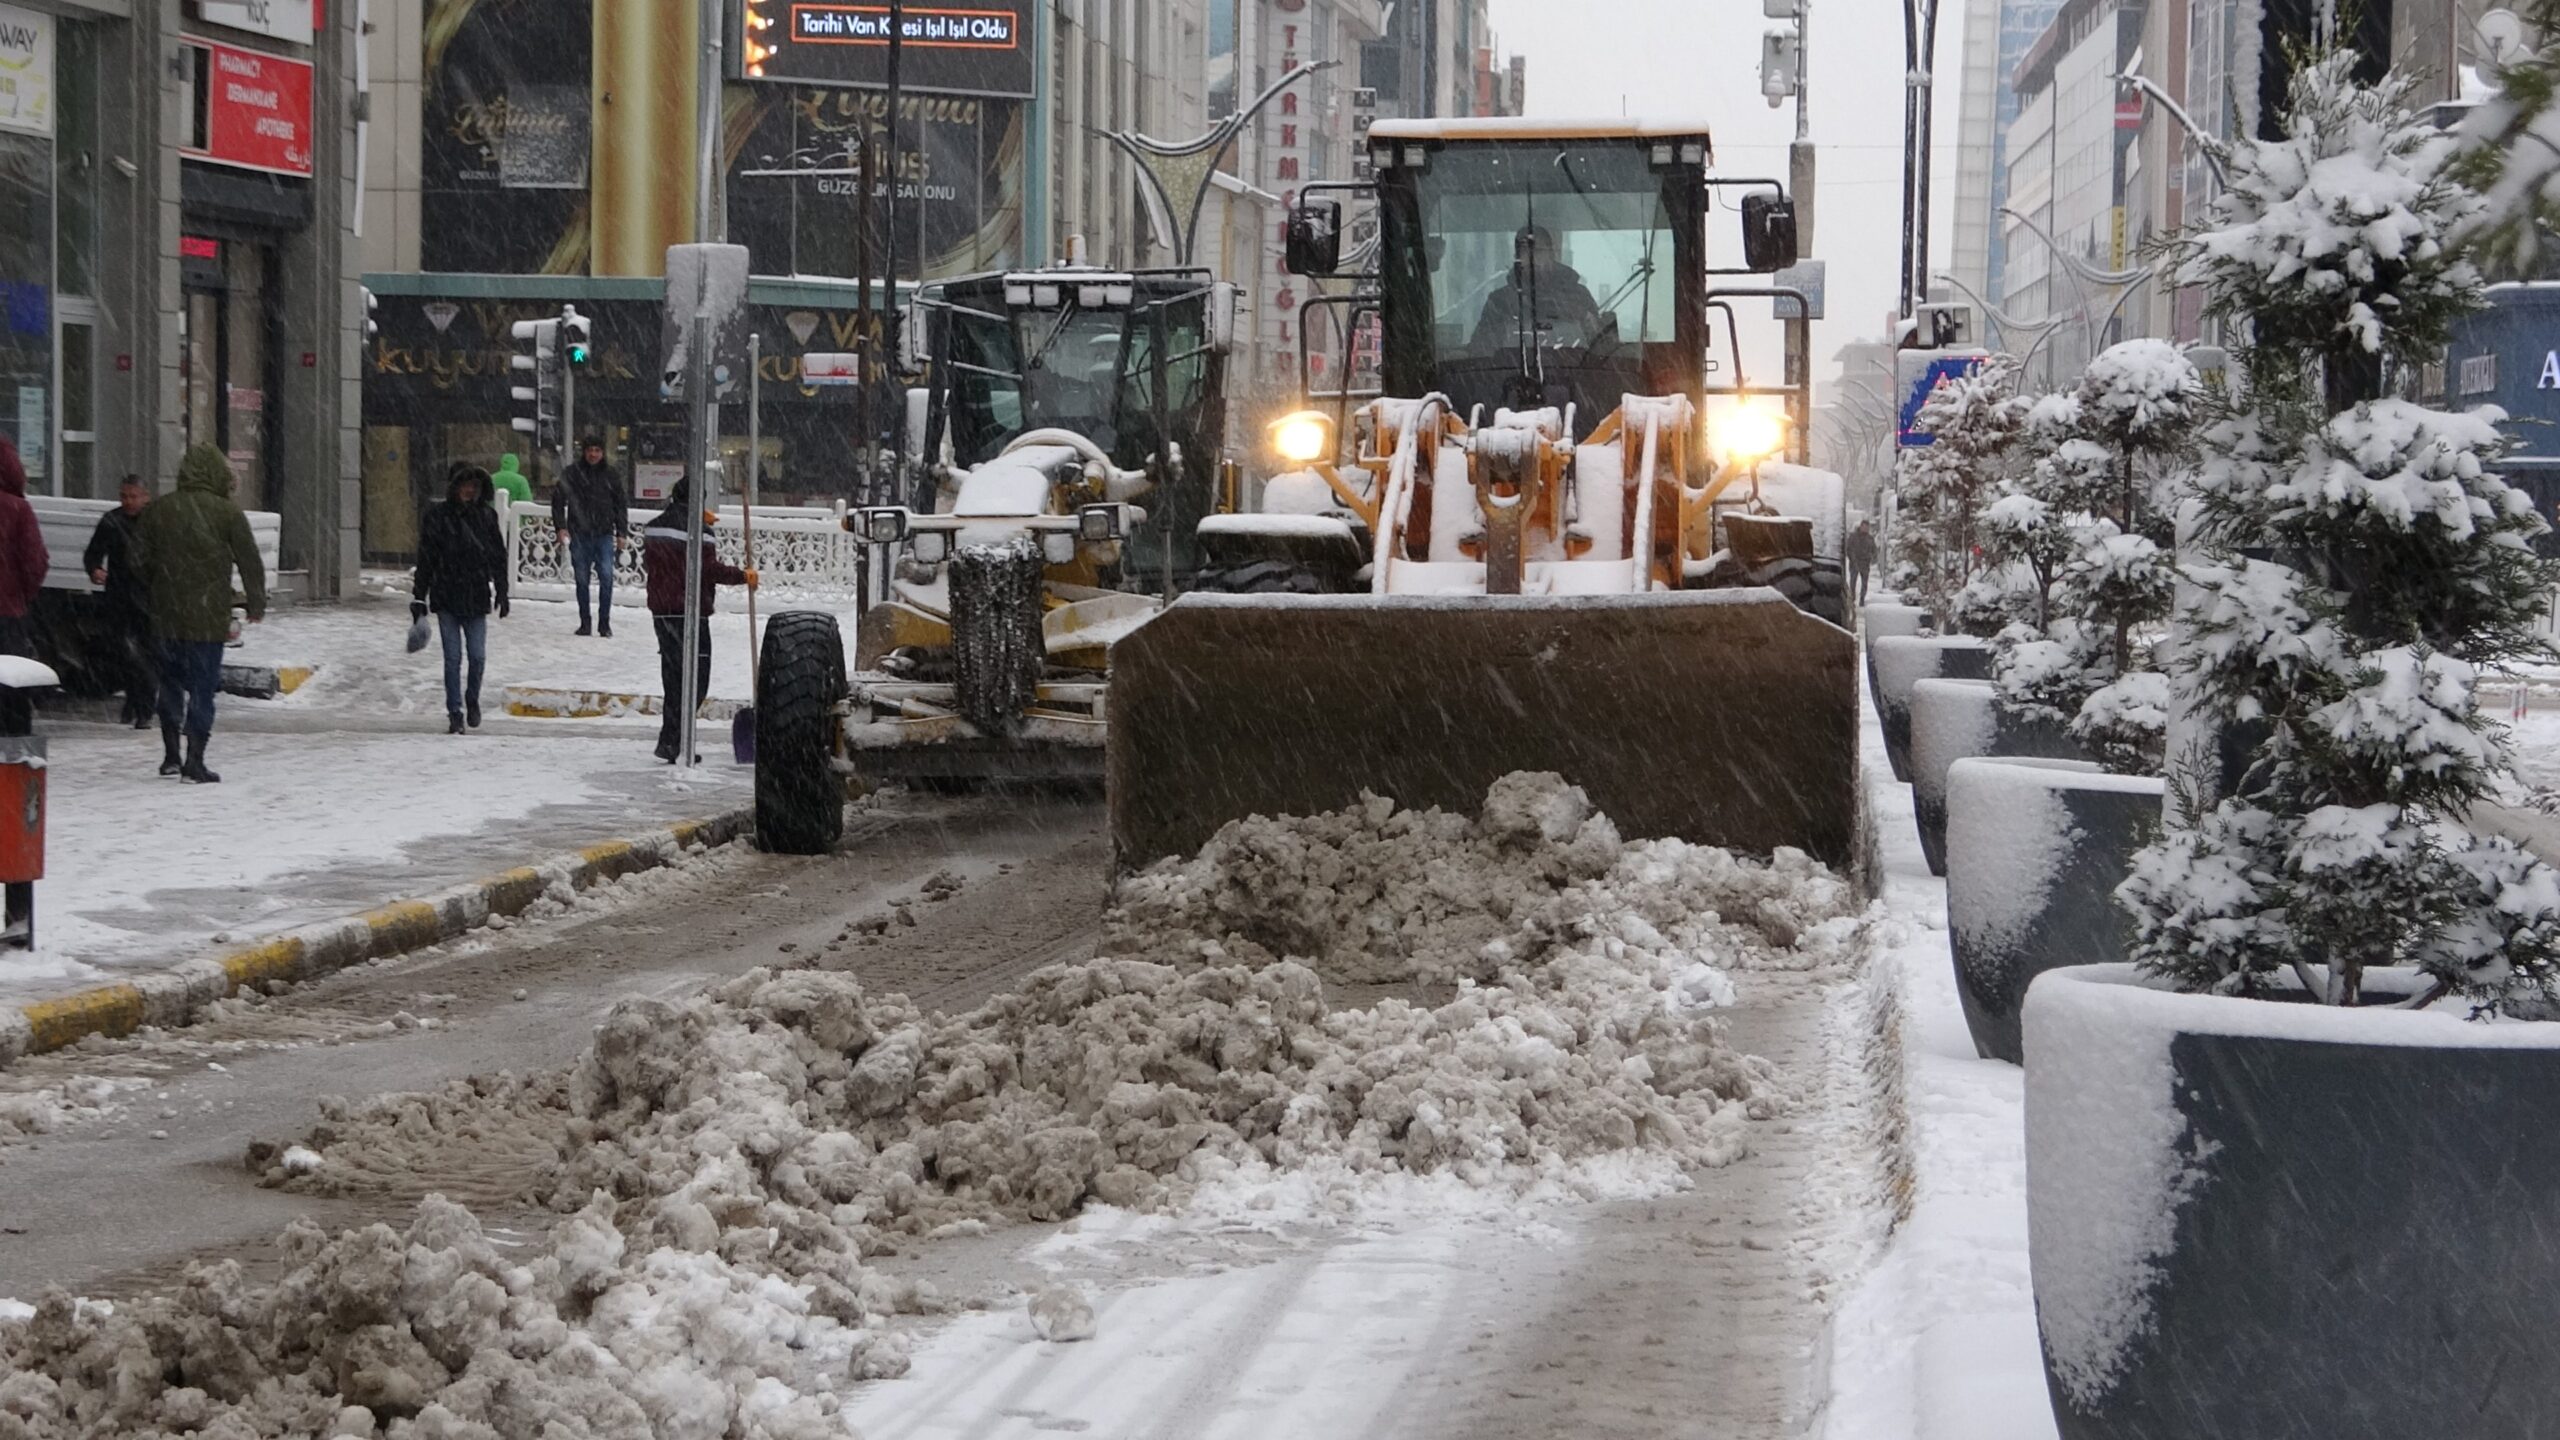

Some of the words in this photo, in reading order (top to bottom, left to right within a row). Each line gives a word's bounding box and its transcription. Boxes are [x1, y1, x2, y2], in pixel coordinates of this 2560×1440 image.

[801, 12, 843, 33] Tarihi
[846, 15, 876, 35] Van
[879, 17, 922, 36] Kesi
[925, 16, 946, 39] Işıl
[949, 17, 968, 39] Işıl
[971, 18, 1008, 39] Oldu
[219, 53, 261, 78] PHARMACY
